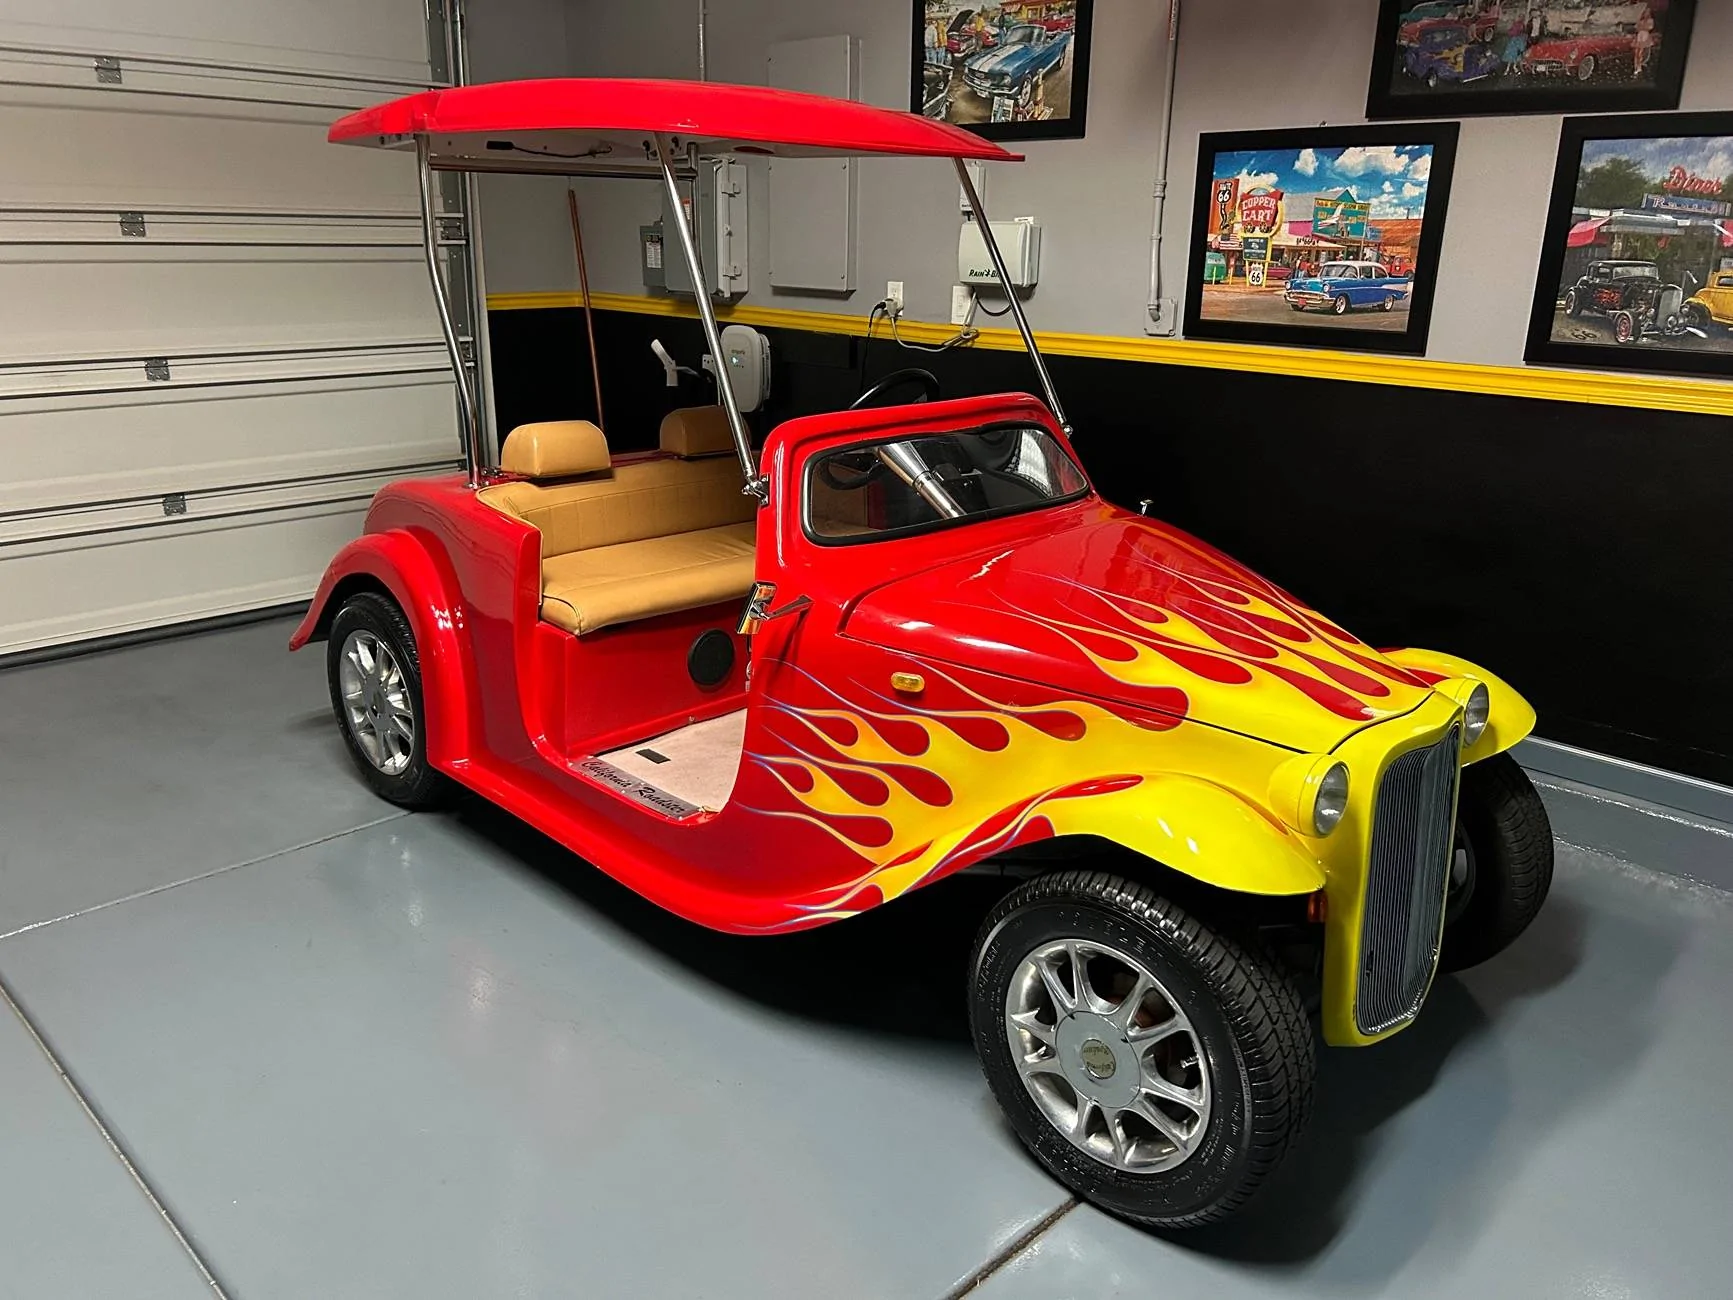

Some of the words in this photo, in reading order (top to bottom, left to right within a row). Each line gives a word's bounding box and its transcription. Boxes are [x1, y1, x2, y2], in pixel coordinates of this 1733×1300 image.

[1217, 190, 1230, 202] 66
[1242, 196, 1276, 210] COPPER
[1243, 209, 1273, 221] CART
[968, 269, 985, 277] RAIN
[1251, 272, 1261, 283] 66
[581, 760, 632, 788] California
[633, 786, 685, 814] Roadster
